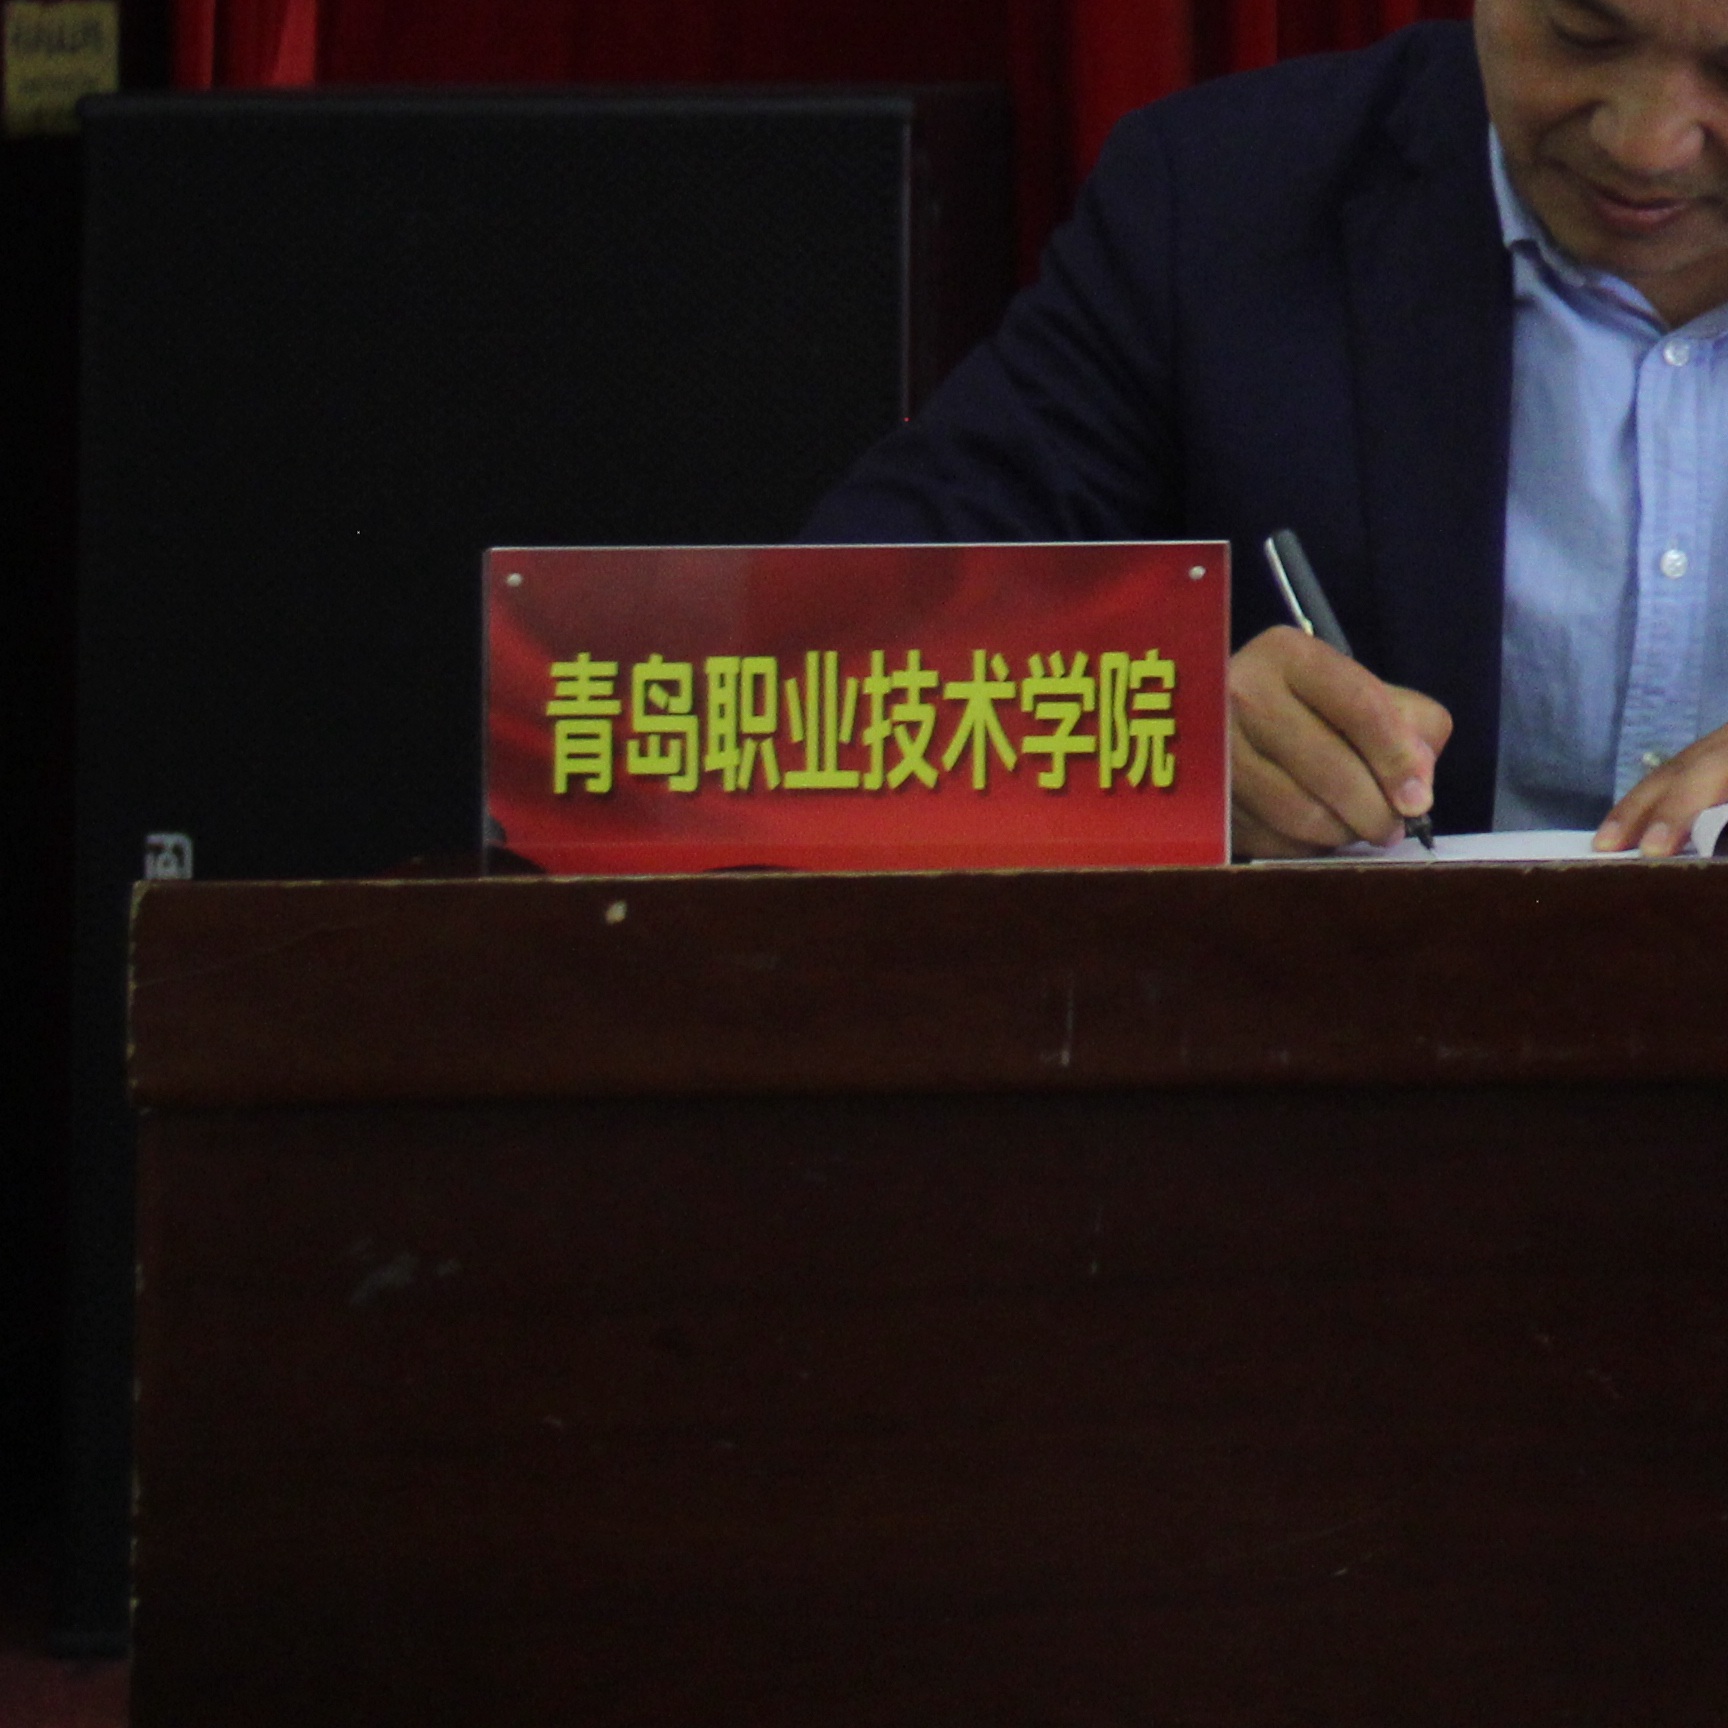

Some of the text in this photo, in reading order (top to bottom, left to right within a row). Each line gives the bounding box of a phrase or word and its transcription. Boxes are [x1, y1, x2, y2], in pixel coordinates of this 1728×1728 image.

[545, 648, 1176, 794] 青岛职业技术学院
